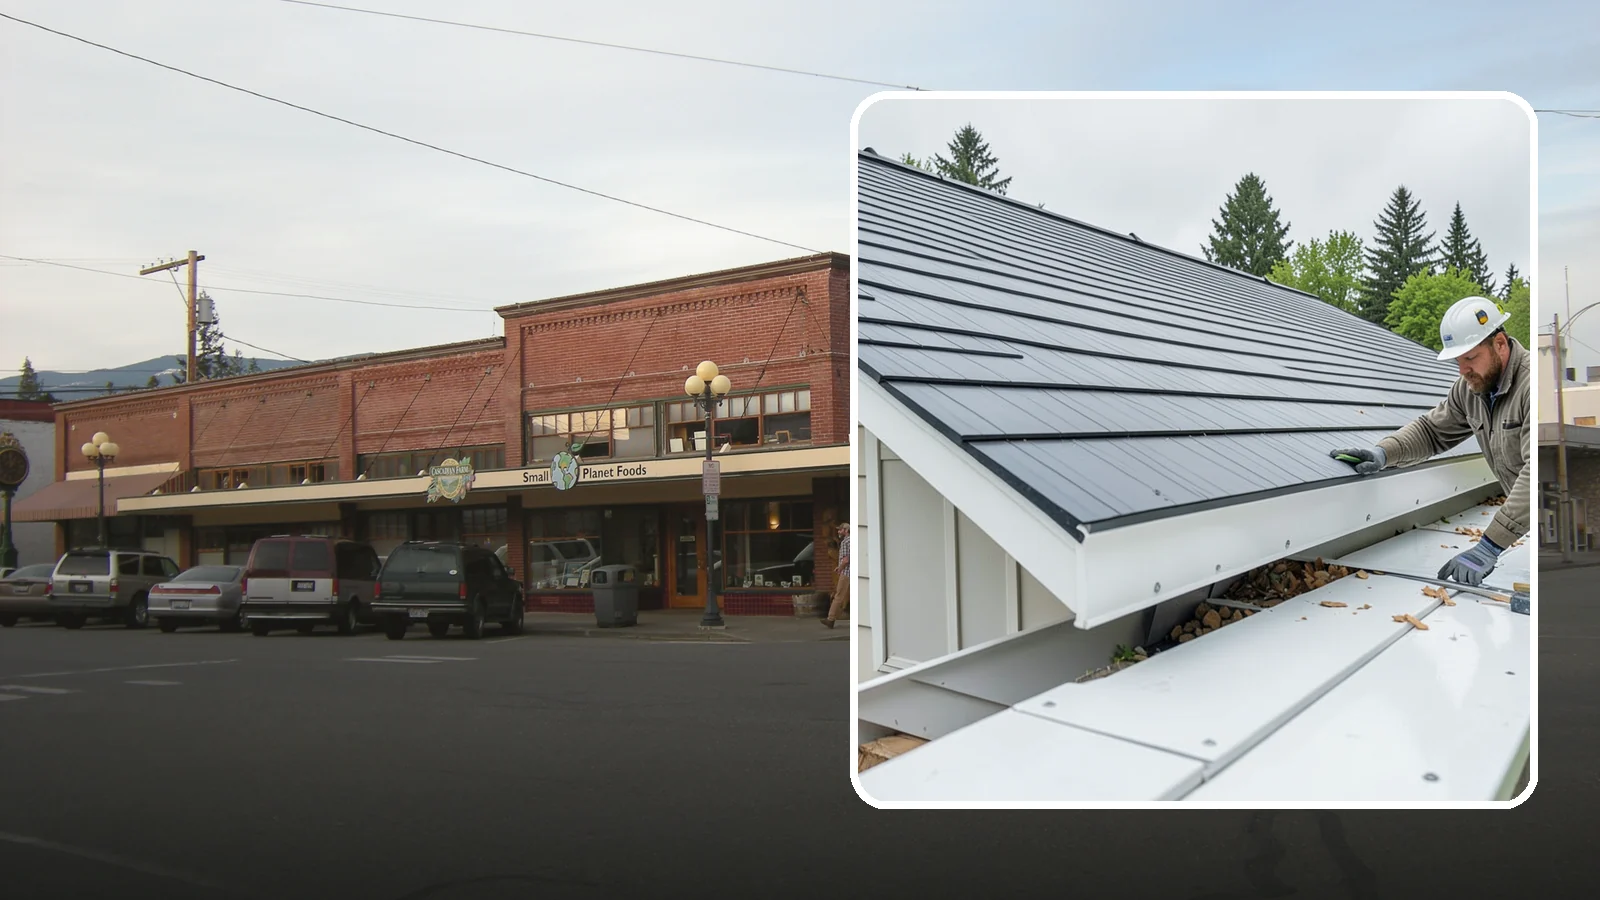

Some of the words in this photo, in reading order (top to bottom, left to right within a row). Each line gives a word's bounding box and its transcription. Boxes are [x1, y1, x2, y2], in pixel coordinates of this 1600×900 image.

[523, 471, 549, 483] Small
[583, 468, 614, 479] Planet
[617, 464, 647, 477] Foods
